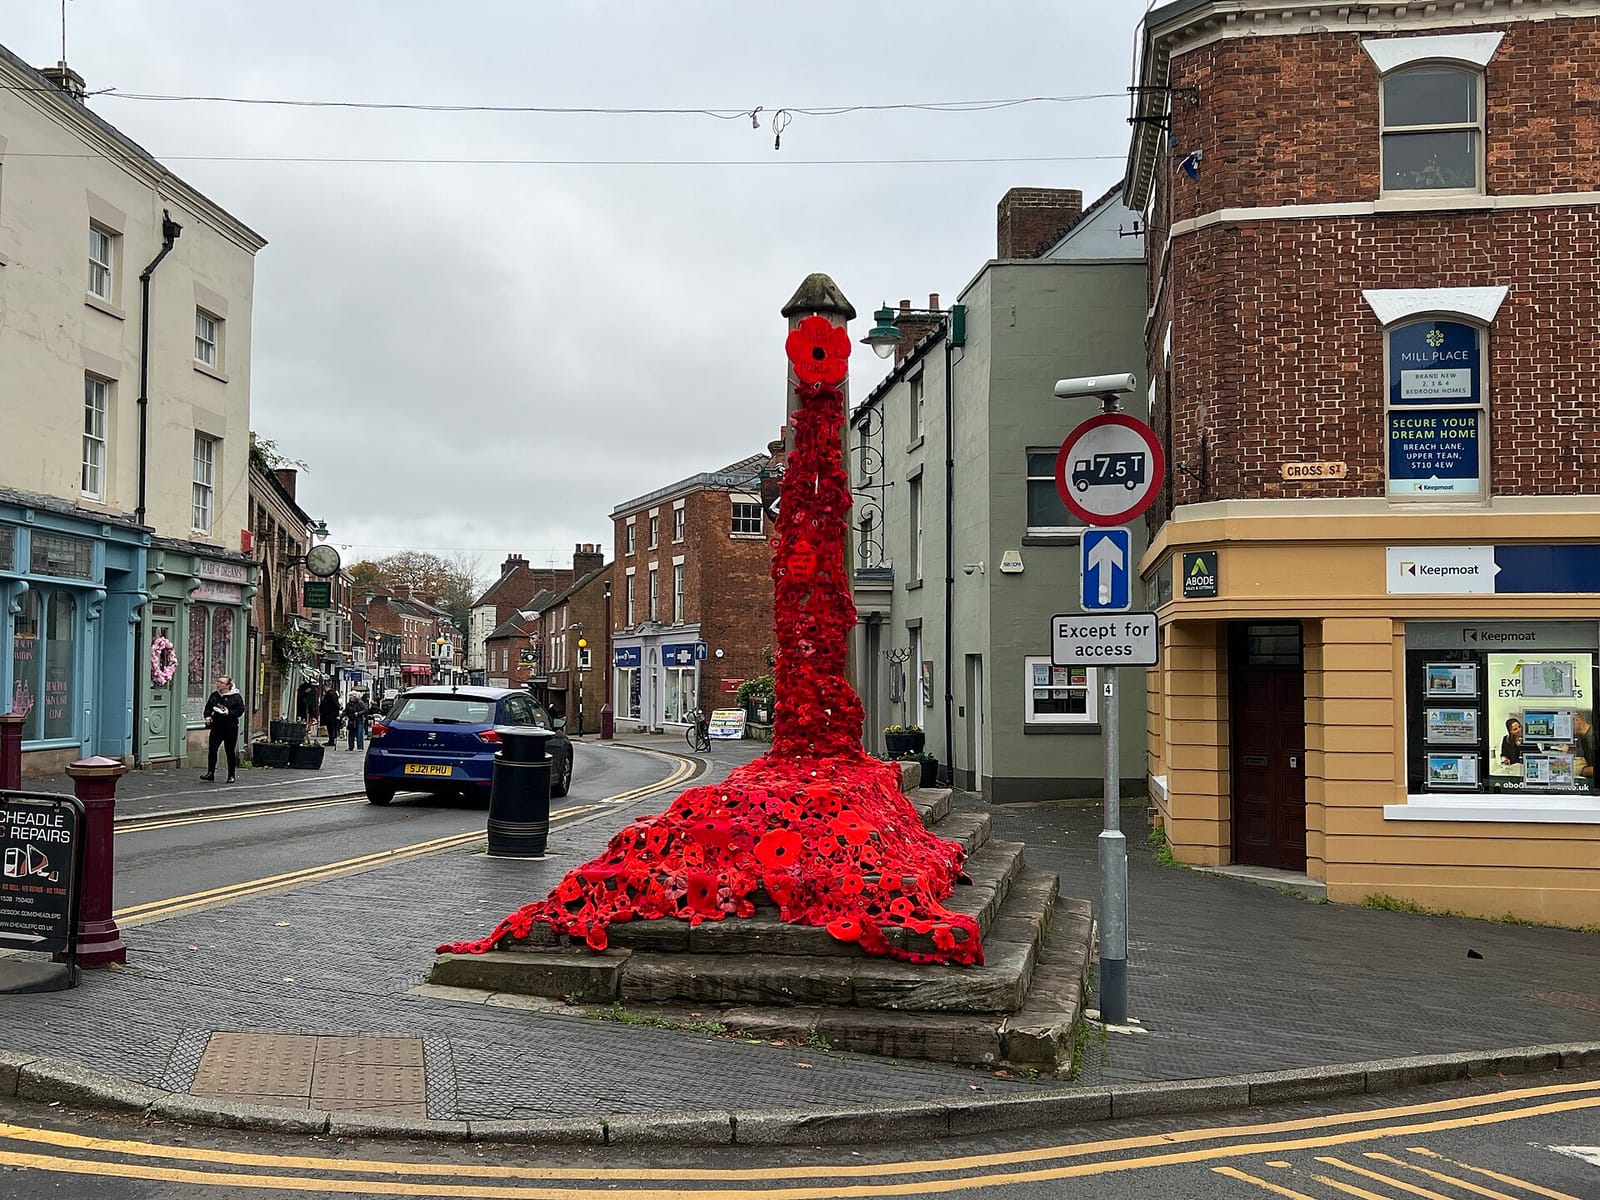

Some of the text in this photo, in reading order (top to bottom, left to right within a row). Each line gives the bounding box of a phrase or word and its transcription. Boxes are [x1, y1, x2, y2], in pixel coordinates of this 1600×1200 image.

[1401, 351, 1469, 361] MILL PLACE
[1393, 418, 1475, 428] SECURE YOUR
[1392, 429, 1476, 439] DREAM HOME
[1403, 443, 1465, 451] BREACH LANE,
[1287, 465, 1323, 476] CROSS
[1411, 461, 1432, 469] ST10
[1419, 564, 1480, 577] Keepmoat
[1185, 575, 1215, 586] ABODE
[1059, 622, 1150, 640] Except for
[1481, 631, 1536, 643] Keepmoat
[1075, 645, 1133, 657] access
[1105, 684, 1111, 695] 4
[410, 764, 447, 775] SJ21 PHU
[0, 810, 64, 828] CHEADLE
[11, 827, 71, 843] REPAIRS
